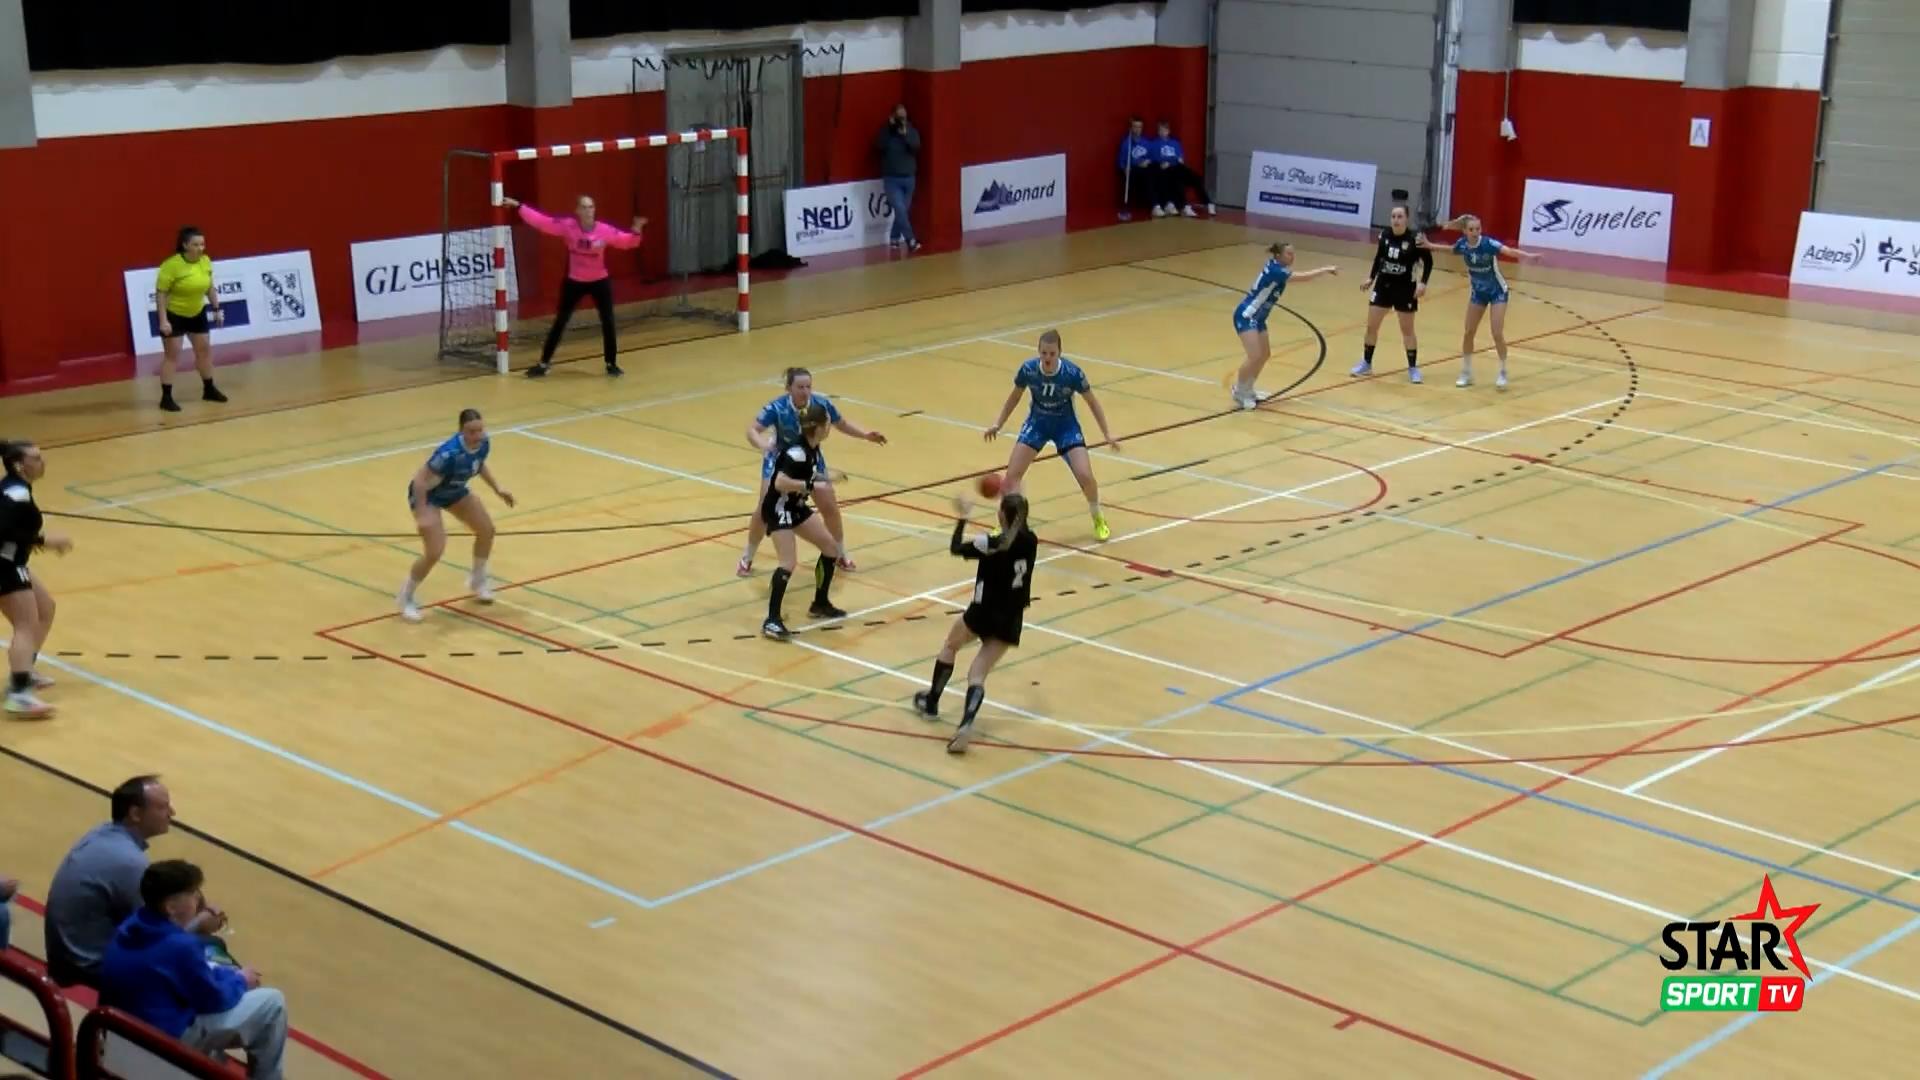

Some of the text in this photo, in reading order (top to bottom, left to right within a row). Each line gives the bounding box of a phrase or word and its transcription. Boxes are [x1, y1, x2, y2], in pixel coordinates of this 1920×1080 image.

[1804, 245, 1852, 264] Adeps
[365, 253, 497, 295] GL CHASSI
